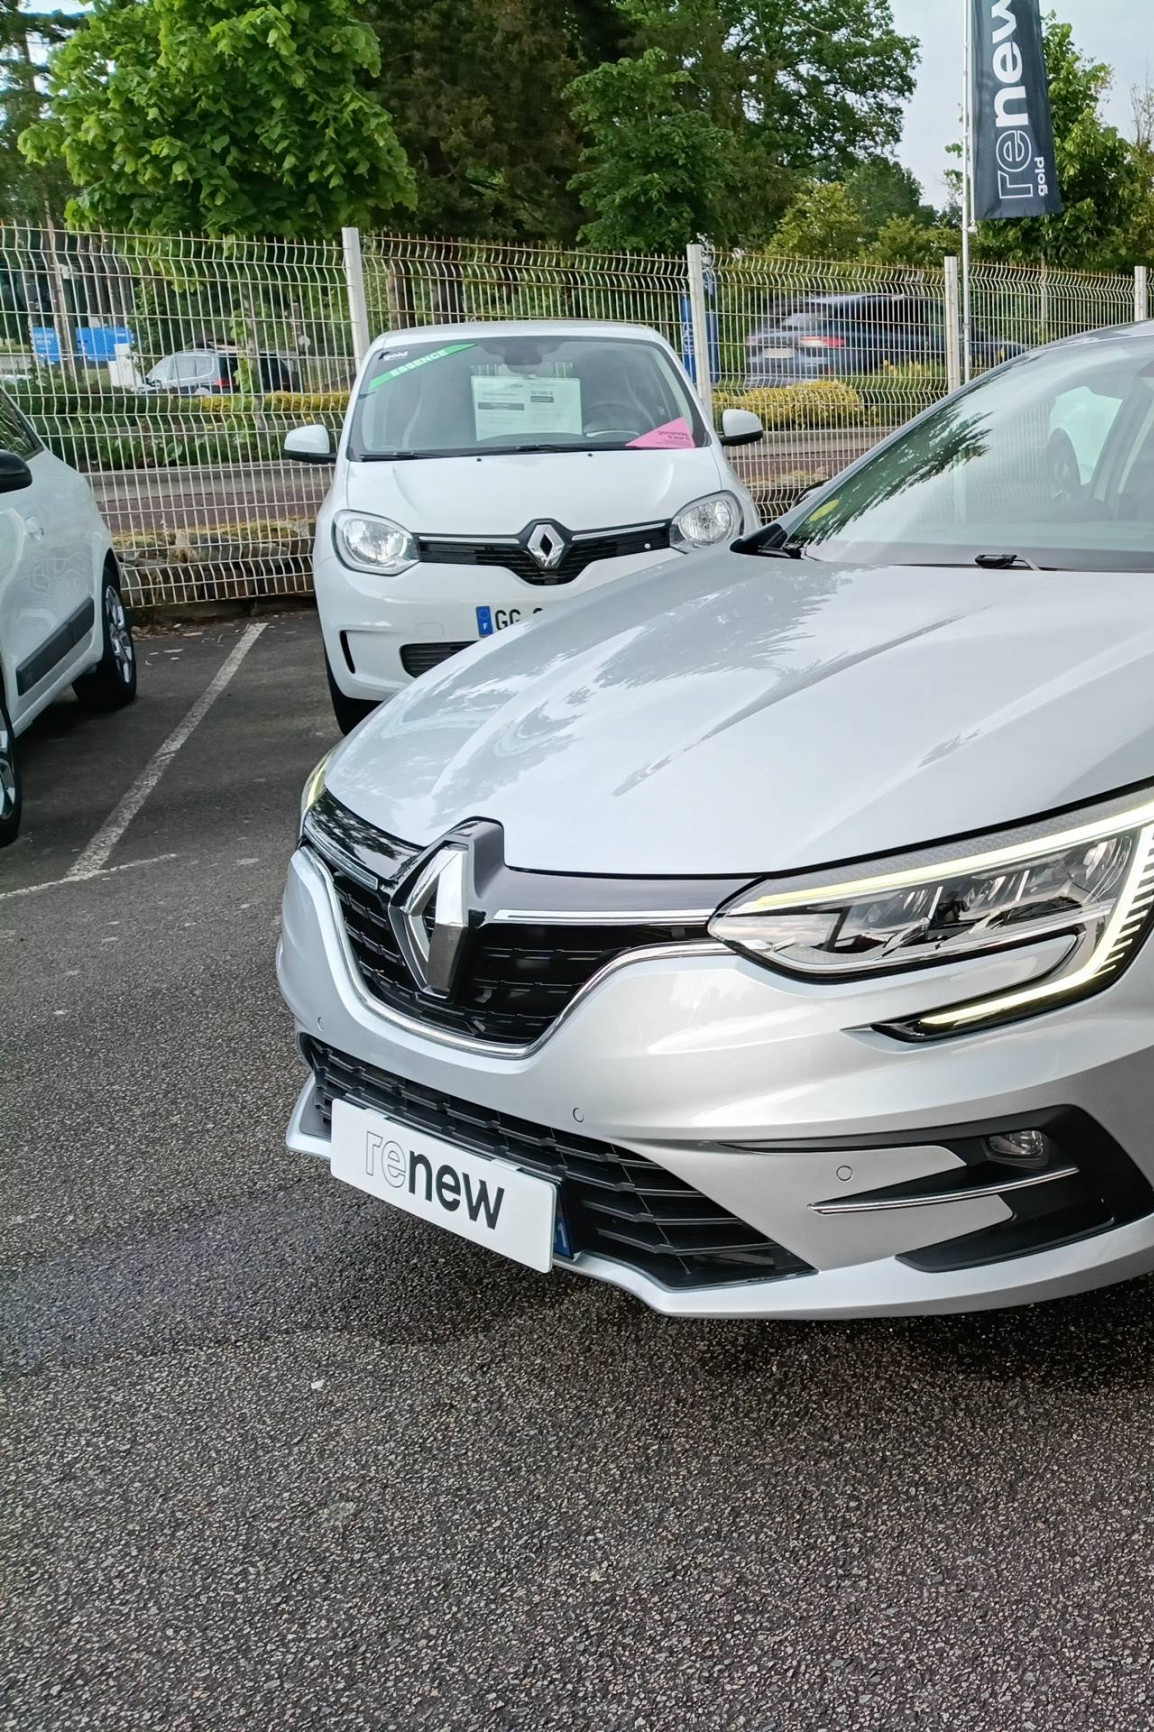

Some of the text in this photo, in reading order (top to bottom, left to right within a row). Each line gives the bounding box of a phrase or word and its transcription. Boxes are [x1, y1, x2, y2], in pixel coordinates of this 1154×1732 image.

[991, 0, 1034, 199] renew
[1034, 156, 1049, 197] gold
[389, 349, 449, 376] ESSENCE
[365, 1130, 505, 1231] renew
